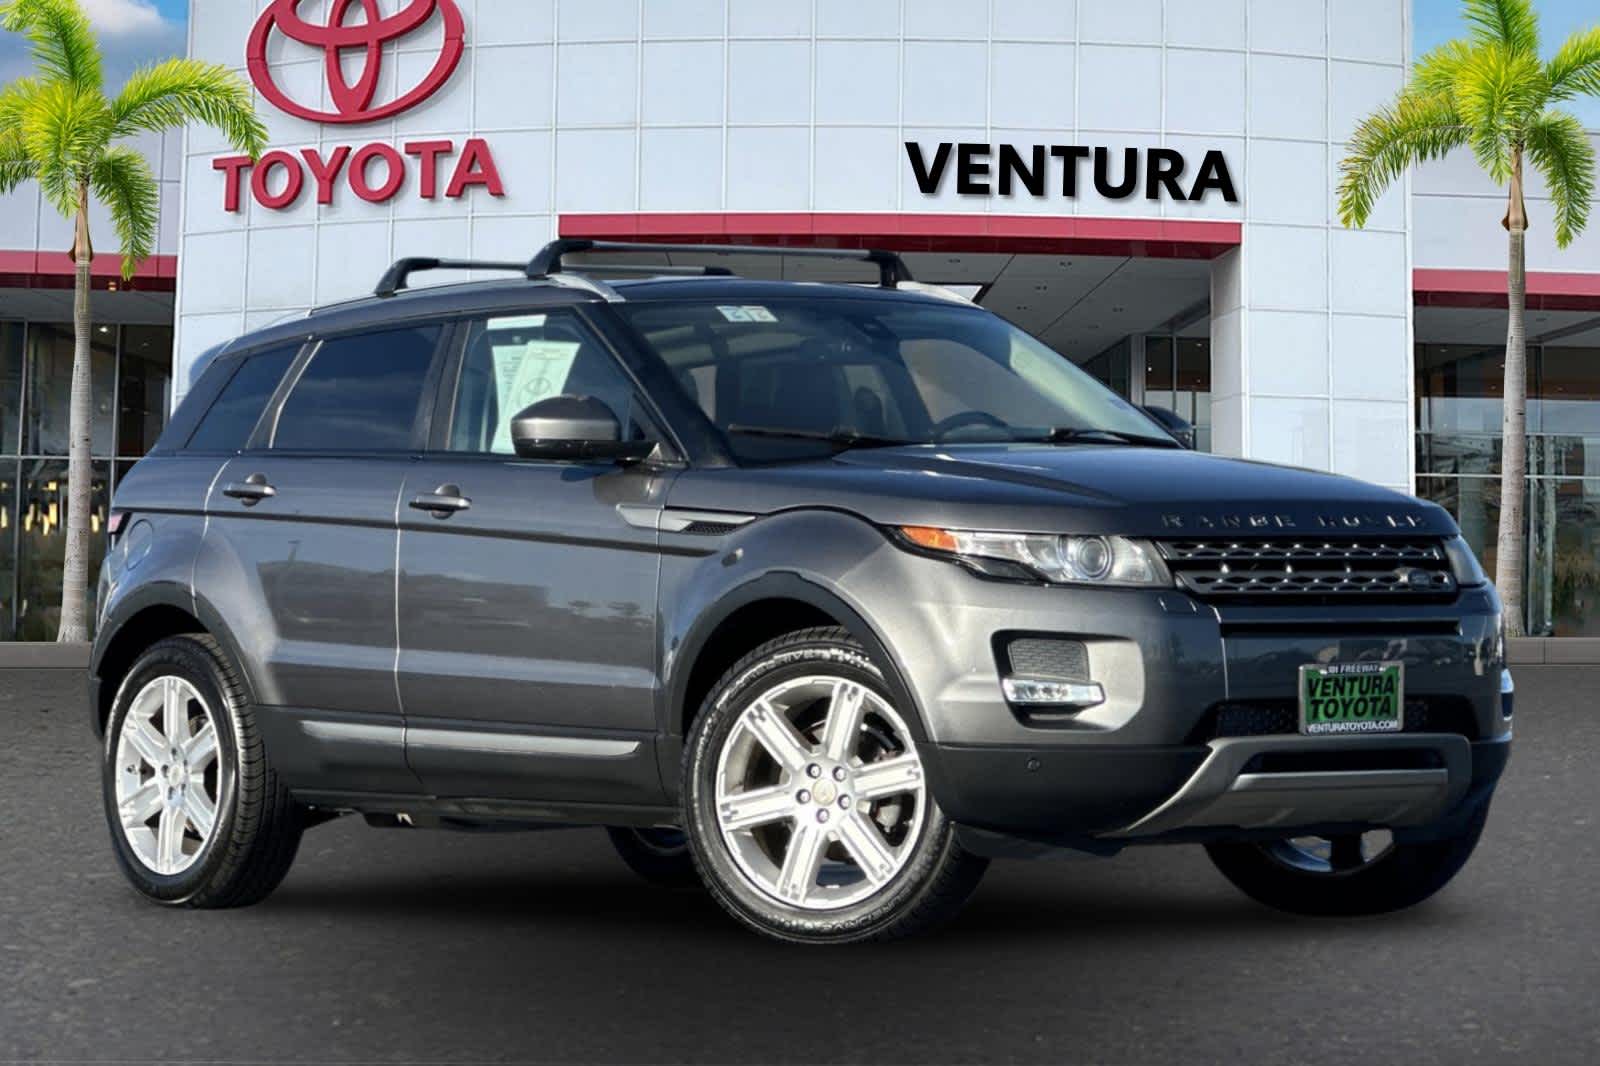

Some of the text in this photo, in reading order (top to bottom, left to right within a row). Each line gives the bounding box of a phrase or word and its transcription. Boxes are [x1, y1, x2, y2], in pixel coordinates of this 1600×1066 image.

[212, 138, 505, 212] TOYOTA
[904, 141, 1238, 202] VENTURA
[1307, 674, 1395, 698] VENTURA
[1311, 695, 1392, 720] TOYOTA
[1308, 720, 1399, 734] VENTURATOYOTA.COM
